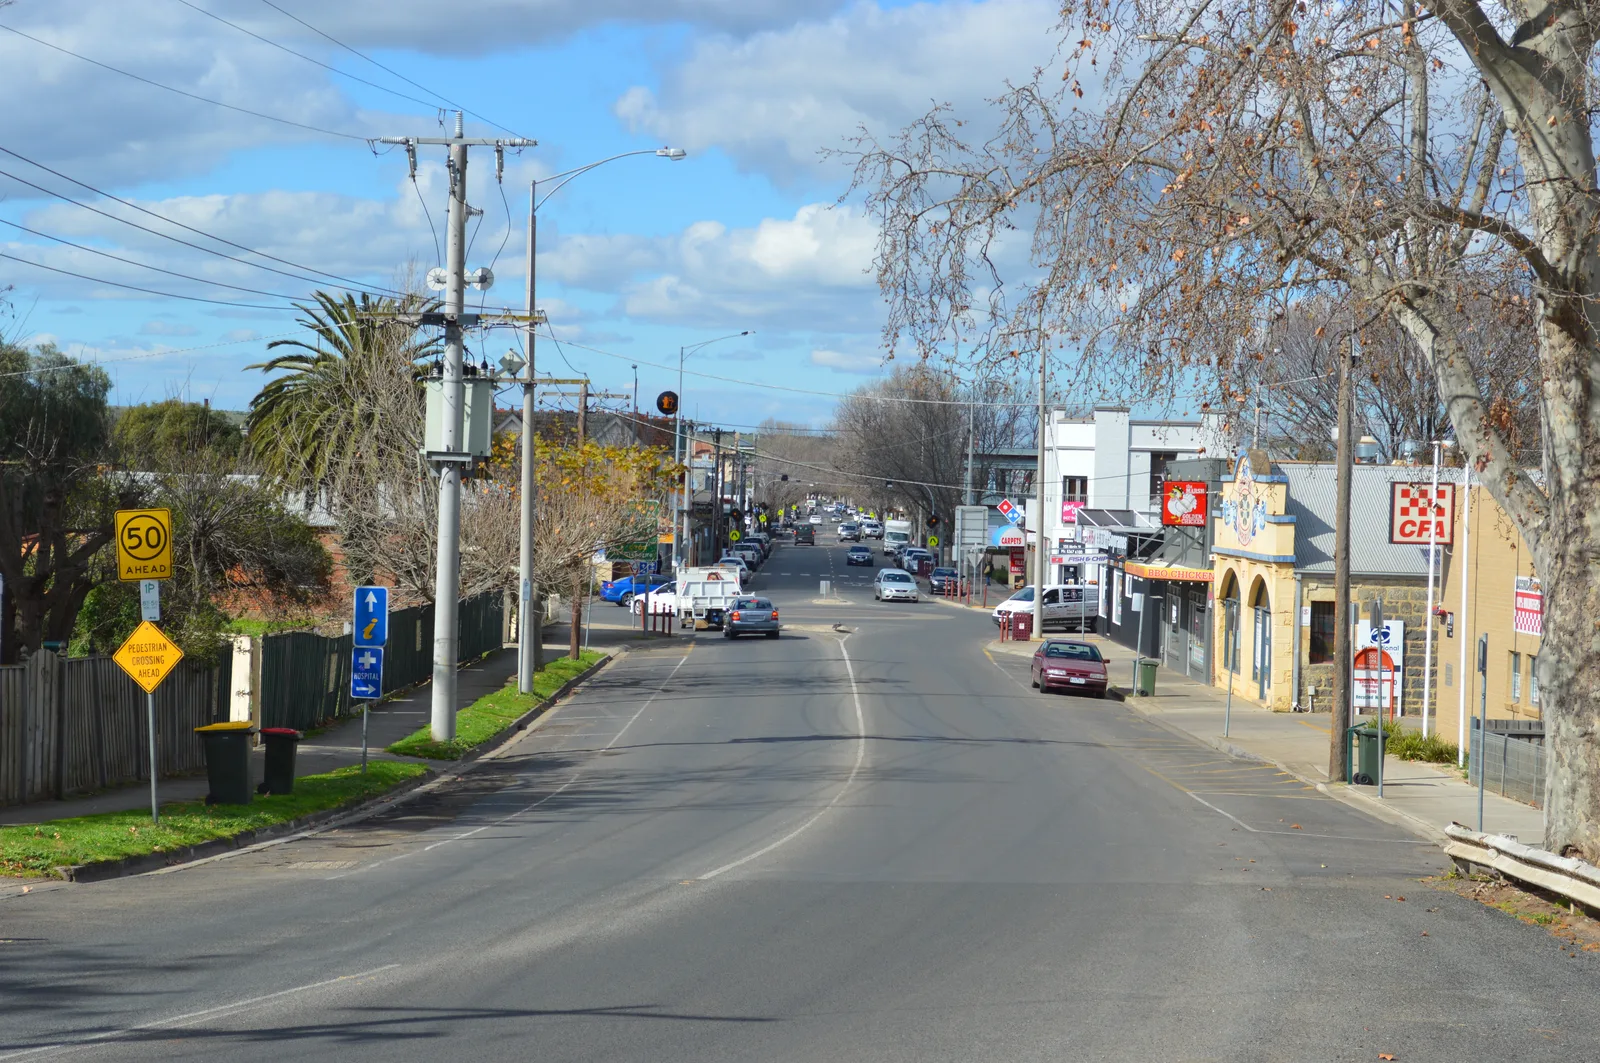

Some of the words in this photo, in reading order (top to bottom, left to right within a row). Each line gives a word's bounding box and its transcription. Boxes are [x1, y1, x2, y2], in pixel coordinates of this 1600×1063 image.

[1399, 519, 1446, 538] CFA
[127, 525, 161, 550] 50
[125, 564, 167, 575] AHEAD
[1148, 569, 1168, 578] BBQ
[1170, 570, 1215, 580] CHICKEN
[144, 583, 155, 594] 1P
[128, 643, 167, 653] PEDESTRIAN
[131, 655, 165, 666] CROSSING
[138, 668, 160, 678] AHEAD
[353, 672, 379, 680] HOSPITAL
